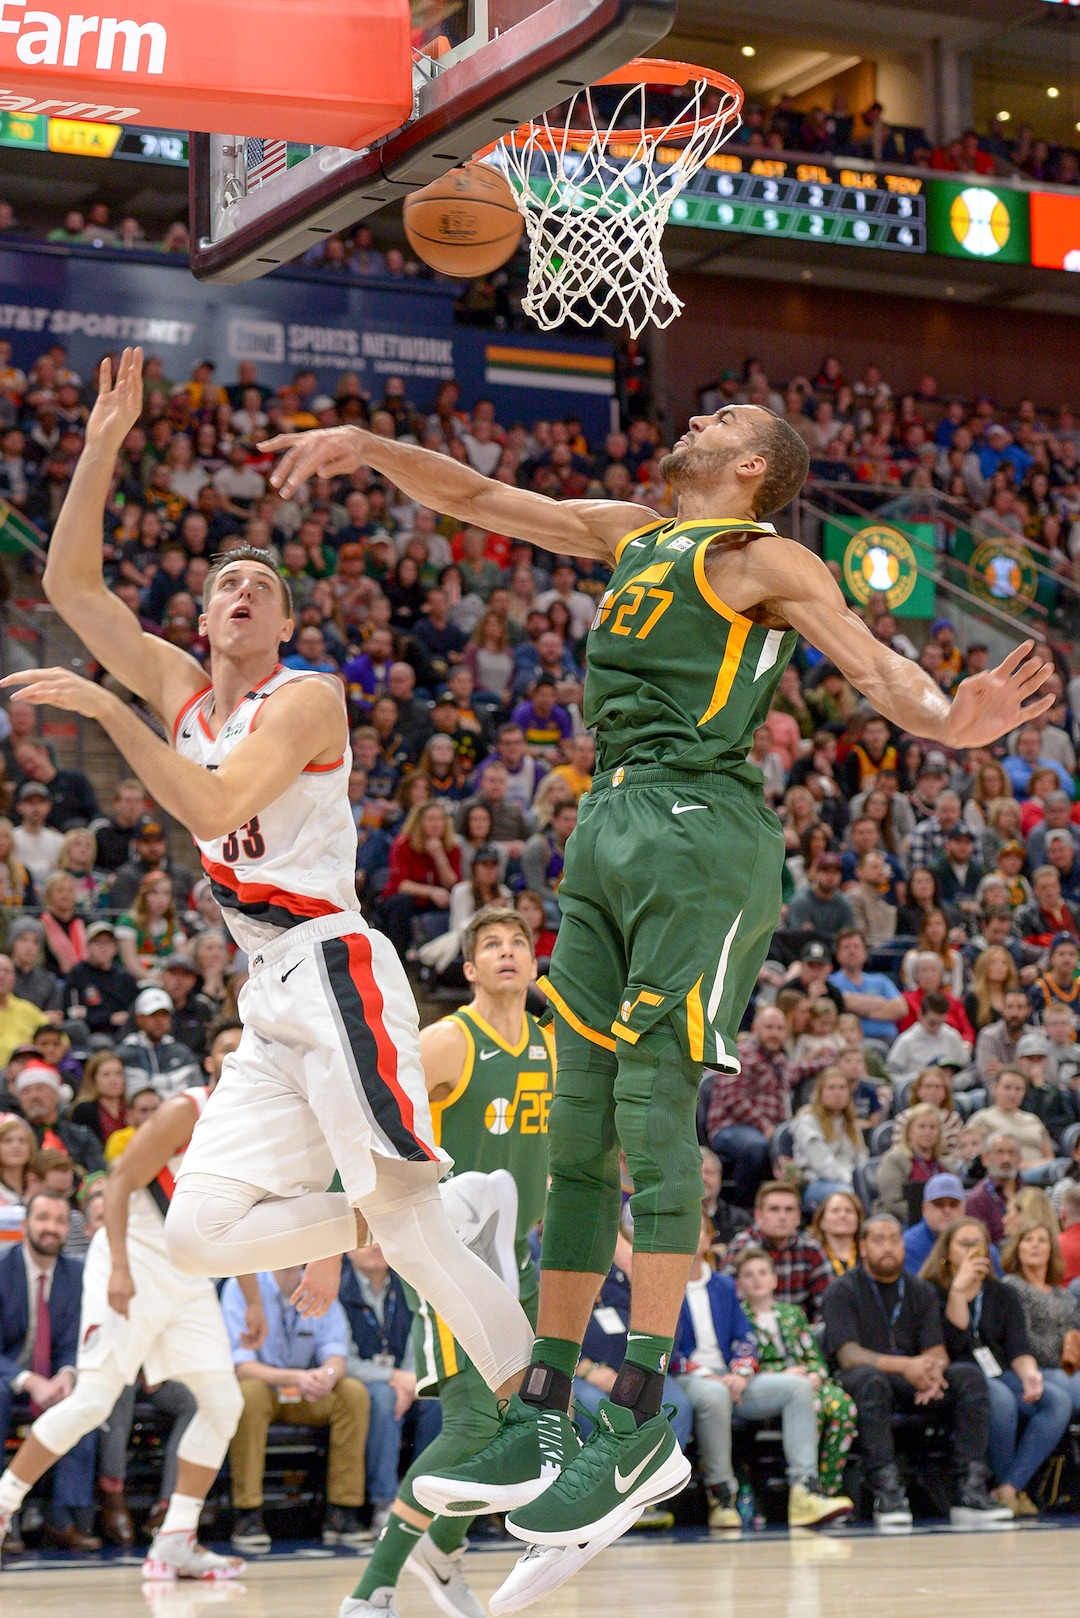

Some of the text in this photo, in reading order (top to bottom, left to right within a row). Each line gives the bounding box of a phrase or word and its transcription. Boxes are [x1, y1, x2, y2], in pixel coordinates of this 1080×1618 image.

[717, 175, 735, 197] 6
[763, 180, 779, 202] 2
[808, 185, 824, 208] 2
[854, 191, 867, 213] 1
[897, 196, 913, 218] 3
[750, 159, 788, 179] AST
[796, 164, 833, 185] STL
[840, 170, 877, 190] BLK
[884, 174, 923, 196] TOV
[717, 203, 735, 226] 9
[763, 209, 780, 231] 5
[809, 214, 825, 237] 2
[852, 220, 871, 242] 0
[897, 225, 914, 247] 4
[287, 323, 360, 355] SPORTS
[360, 331, 454, 365] NETWORK
[609, 585, 675, 641] 27
